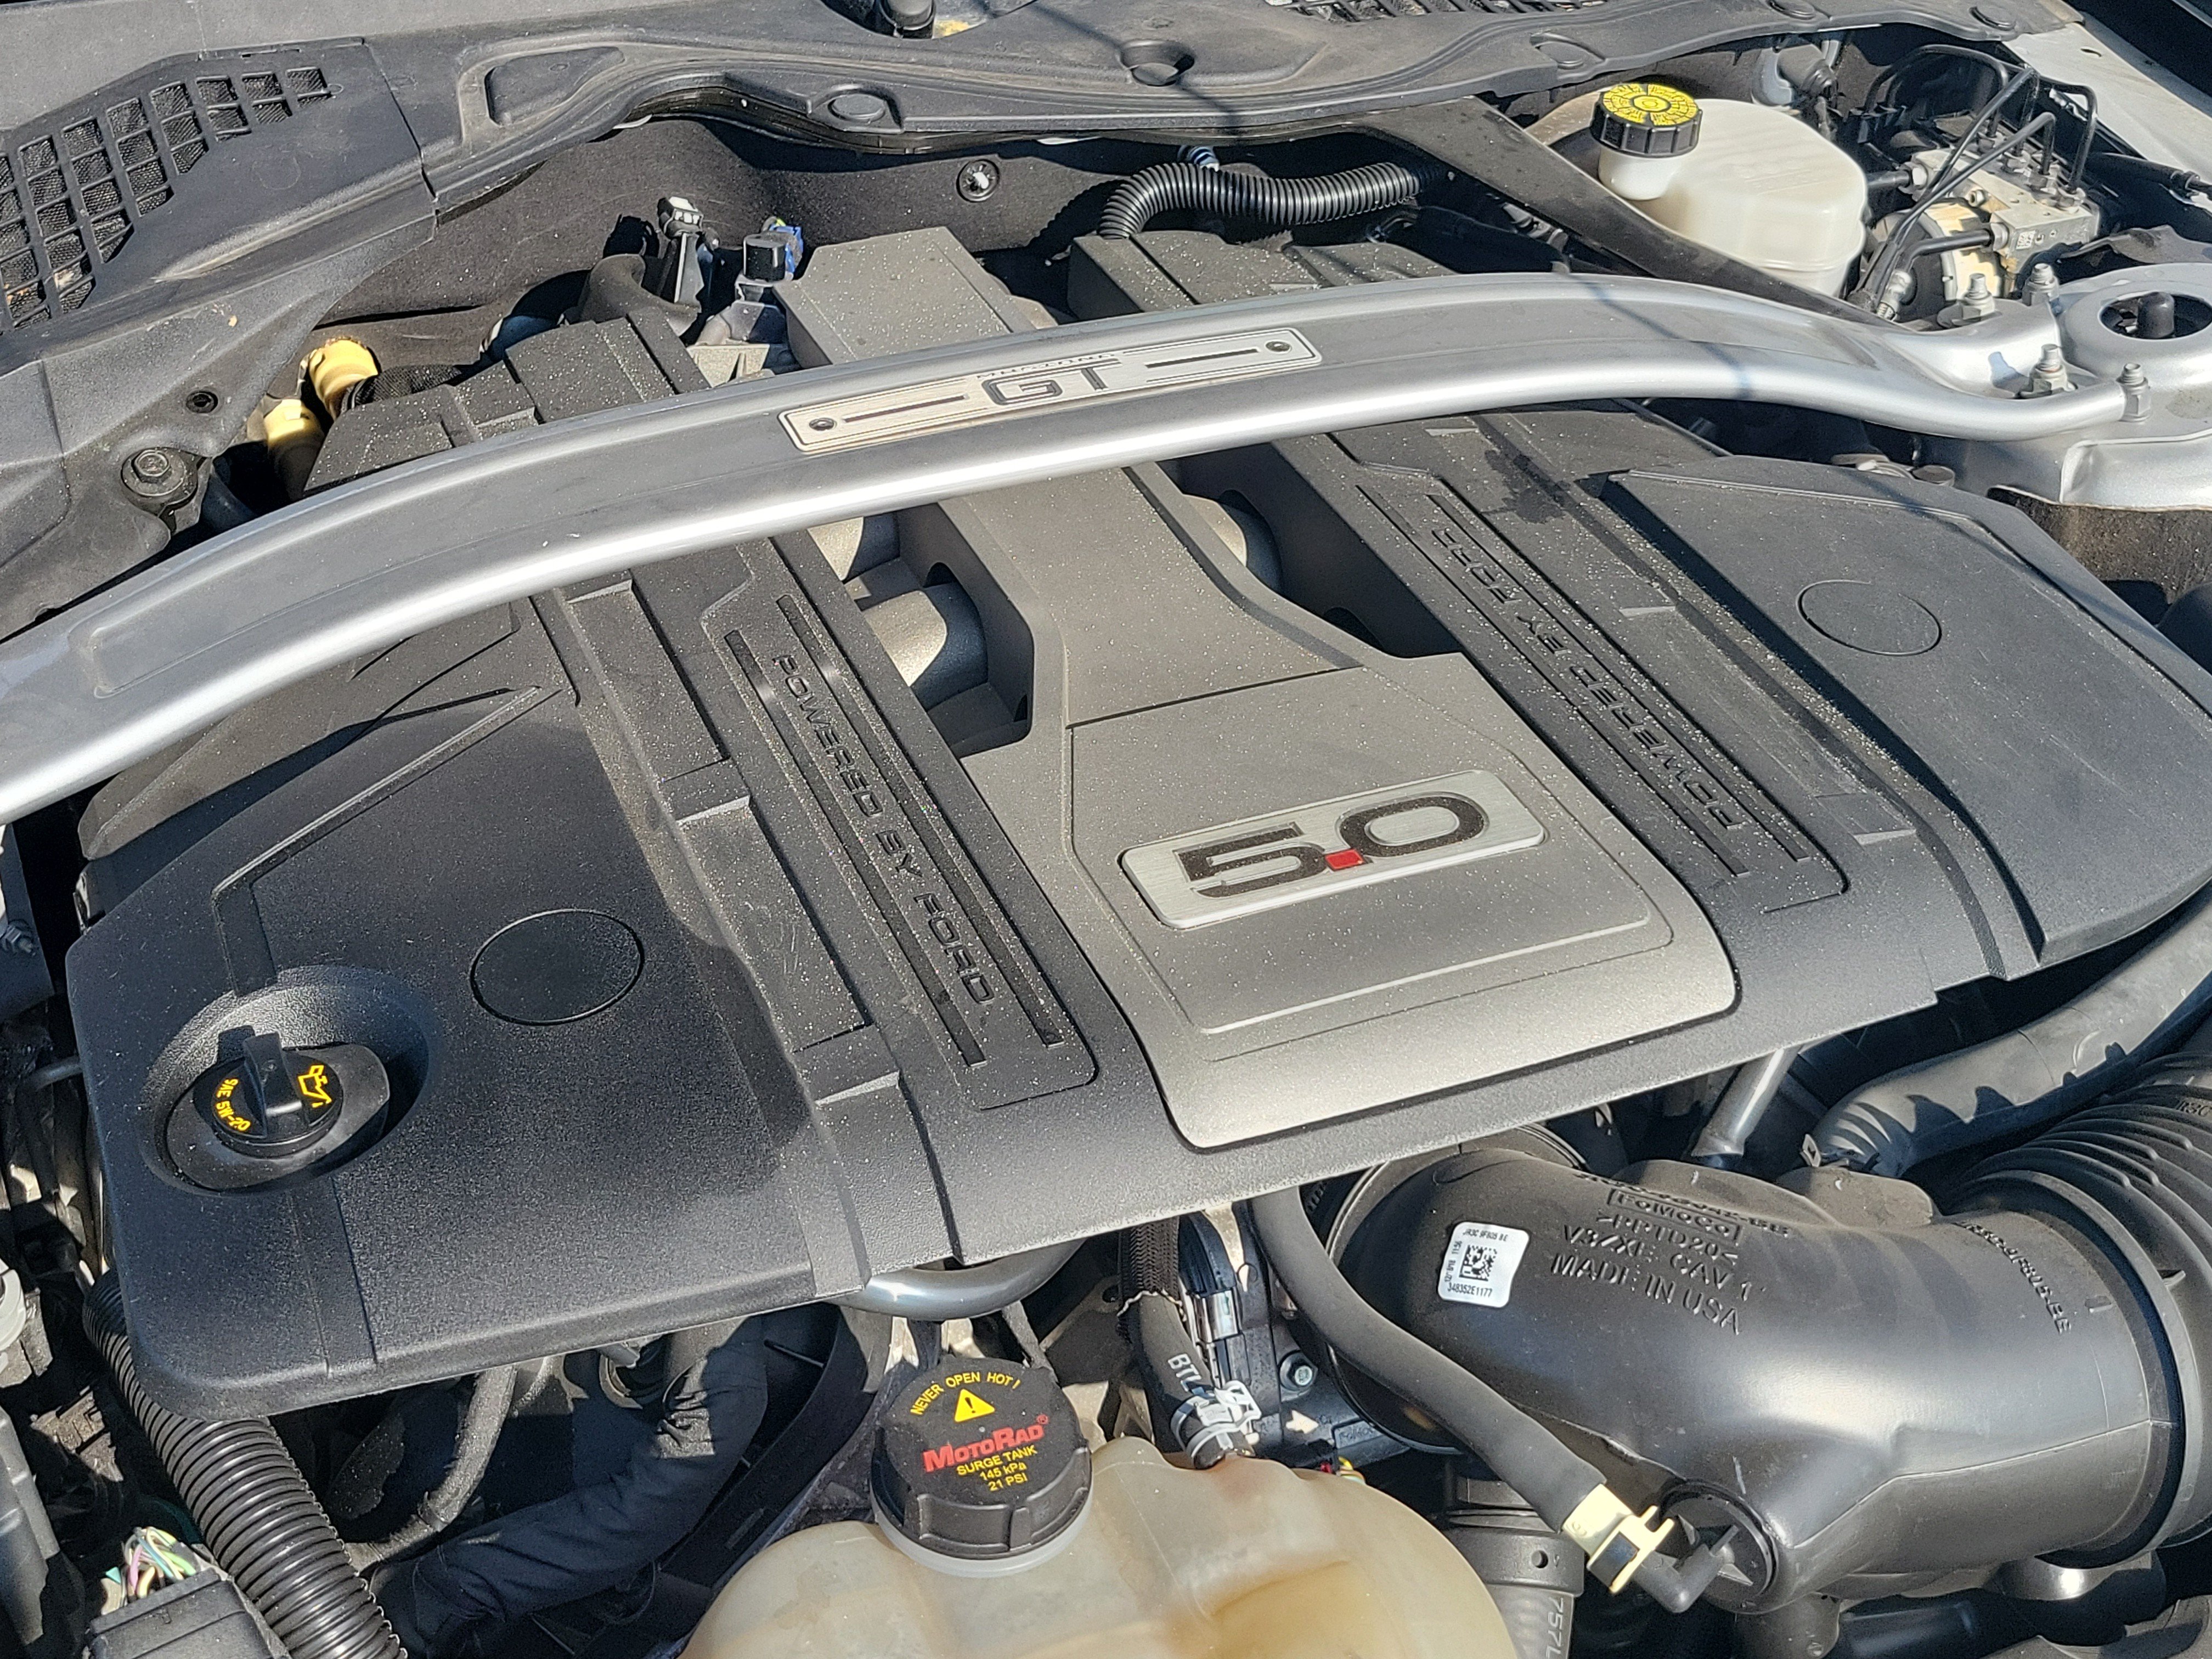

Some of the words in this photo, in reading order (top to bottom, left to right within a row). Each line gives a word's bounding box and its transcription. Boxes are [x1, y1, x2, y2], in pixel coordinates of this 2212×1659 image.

[981, 357, 1122, 406] GT
[1431, 528, 1523, 605] FORD
[1515, 614, 1570, 655] BY
[1569, 665, 1748, 831] POWERED
[771, 654, 883, 817] POWERED
[876, 830, 923, 878] BY
[913, 892, 995, 1005] FORD
[1173, 791, 1488, 898] 5.0
[217, 1078, 239, 1098] SAE
[216, 1100, 251, 1131] 5W-20
[1671, 1253, 1735, 1290] CAV
[1551, 1253, 1641, 1293] MADE
[1646, 1273, 1677, 1304] IN
[1683, 1288, 1739, 1335] USA
[910, 1384, 944, 1415] NEVER
[945, 1372, 981, 1388] OPEN
[956, 1455, 1003, 1476] SURGE
[1002, 1444, 1038, 1461] TANK
[980, 1468, 1002, 1481] 145
[1003, 1462, 1027, 1474] kPa
[988, 1480, 1004, 1492] 21
[1005, 1472, 1028, 1486] PSI
